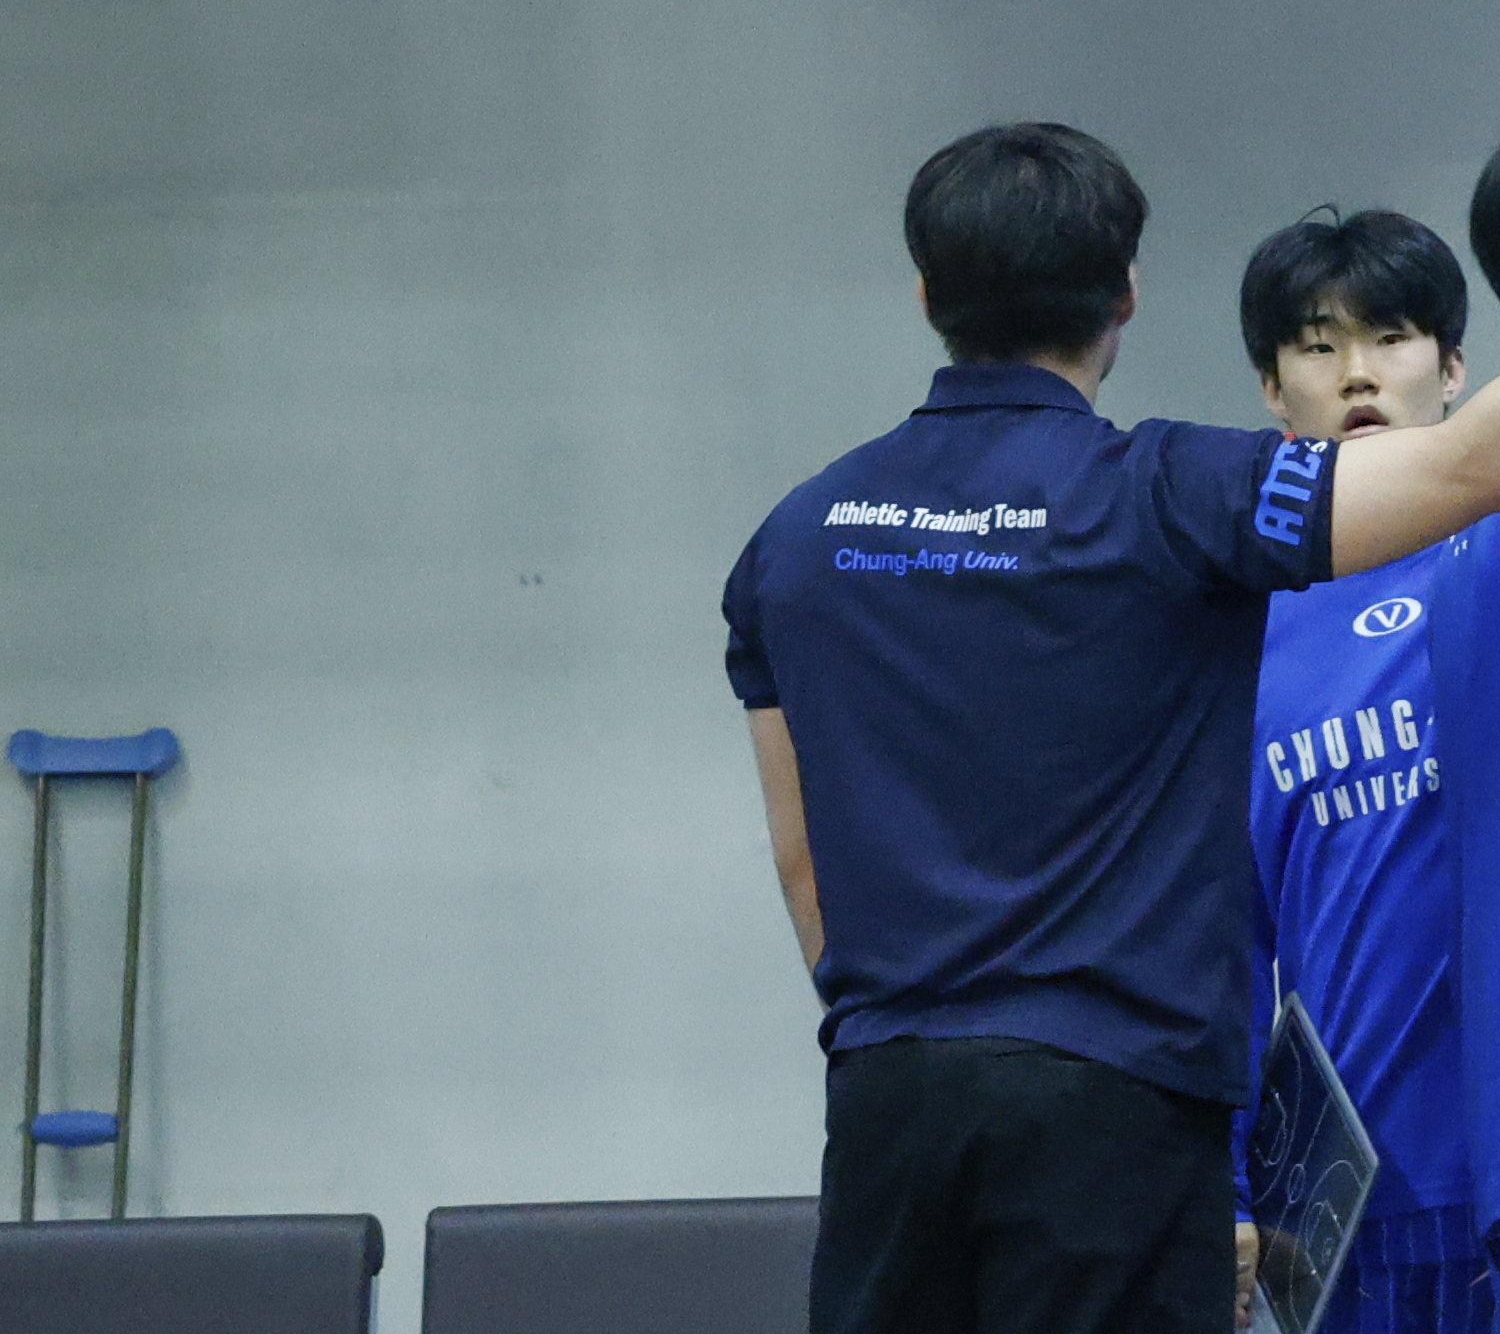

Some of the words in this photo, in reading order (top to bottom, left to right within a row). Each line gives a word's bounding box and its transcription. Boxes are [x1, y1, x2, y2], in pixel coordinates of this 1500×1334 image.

[824, 502, 908, 529] Athletic
[910, 507, 992, 535] Training
[994, 503, 1047, 530] Team
[834, 547, 957, 576] Chung-Ang
[962, 549, 1020, 571] Univ.
[1267, 699, 1419, 792] CHUNG
